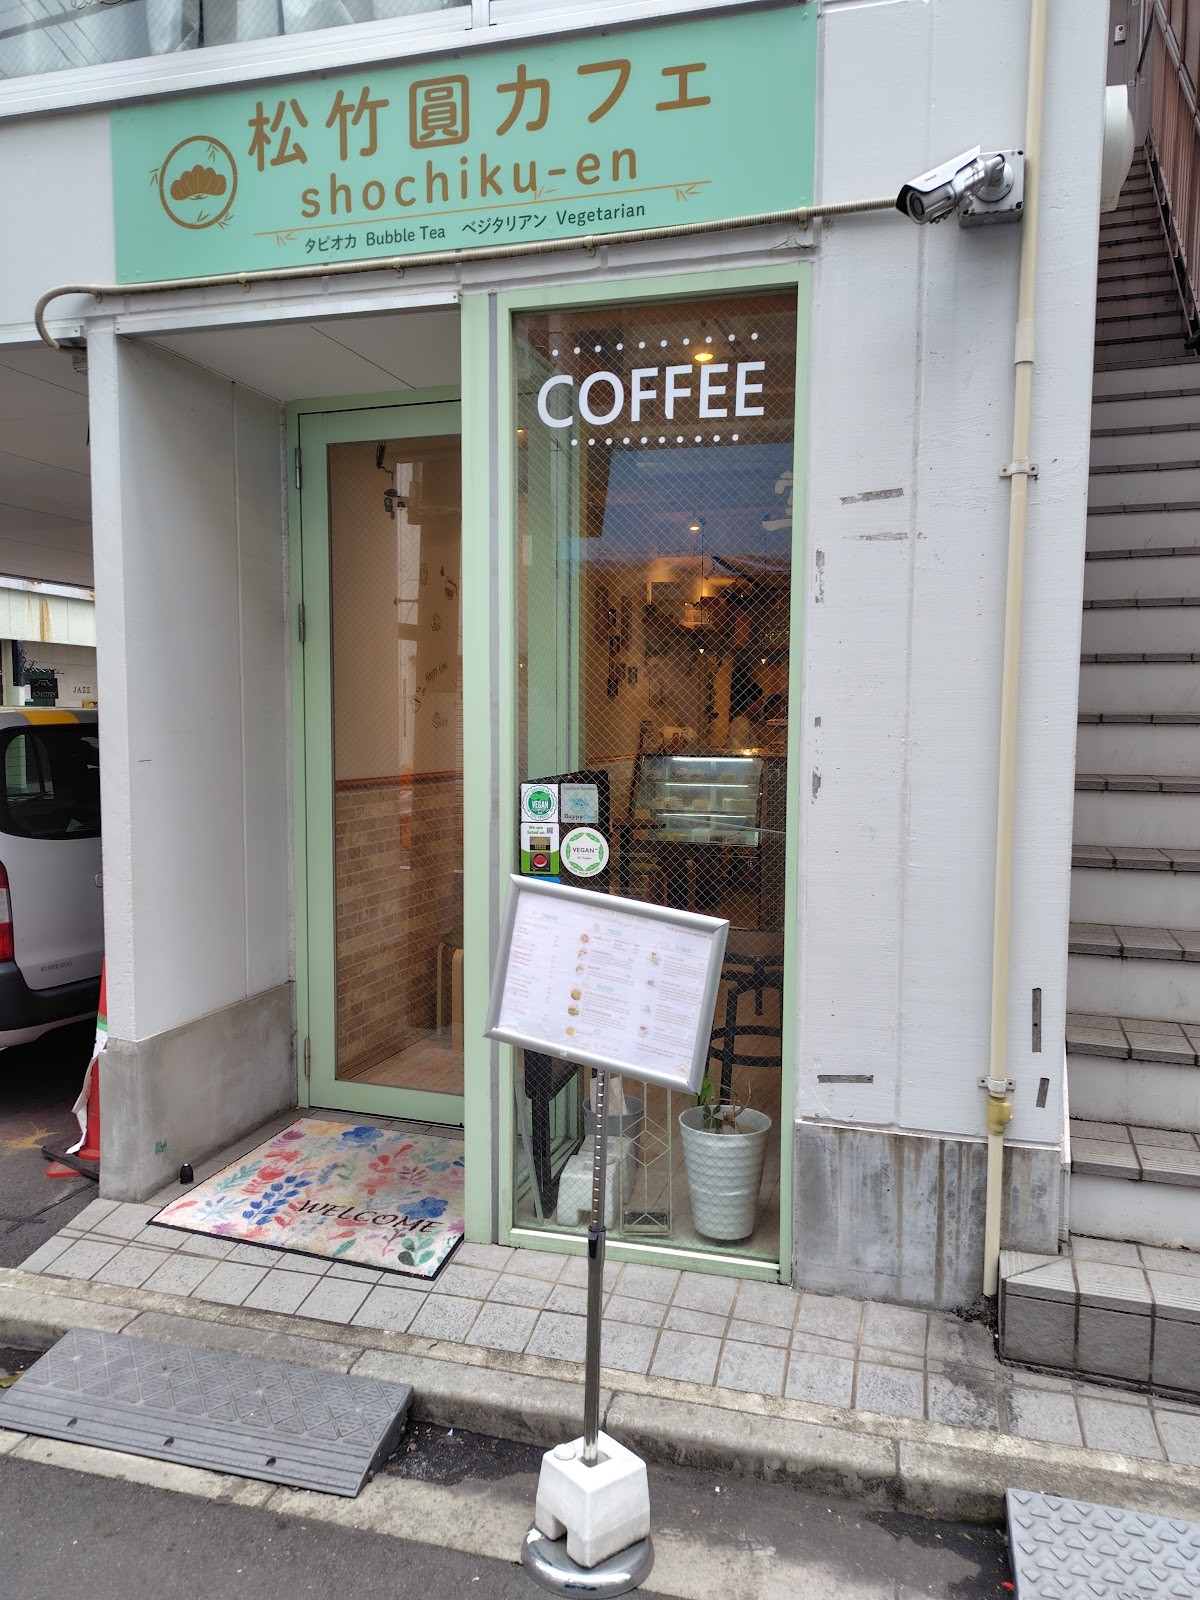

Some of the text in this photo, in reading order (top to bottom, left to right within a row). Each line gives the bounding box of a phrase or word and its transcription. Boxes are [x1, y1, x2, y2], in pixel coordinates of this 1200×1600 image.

[247, 58, 711, 172] 松竹圓カフェ
[301, 148, 637, 218] shochiku-en
[461, 214, 547, 235] ベジタリアン
[556, 203, 646, 227] Vegetarian
[305, 234, 357, 254] タピオカ
[366, 225, 446, 246] Bubble Tea
[537, 361, 766, 428] COFFEE
[73, 686, 91, 694] JAZZ
[531, 800, 549, 809] VEGAN
[298, 1200, 444, 1233] WELCOME
